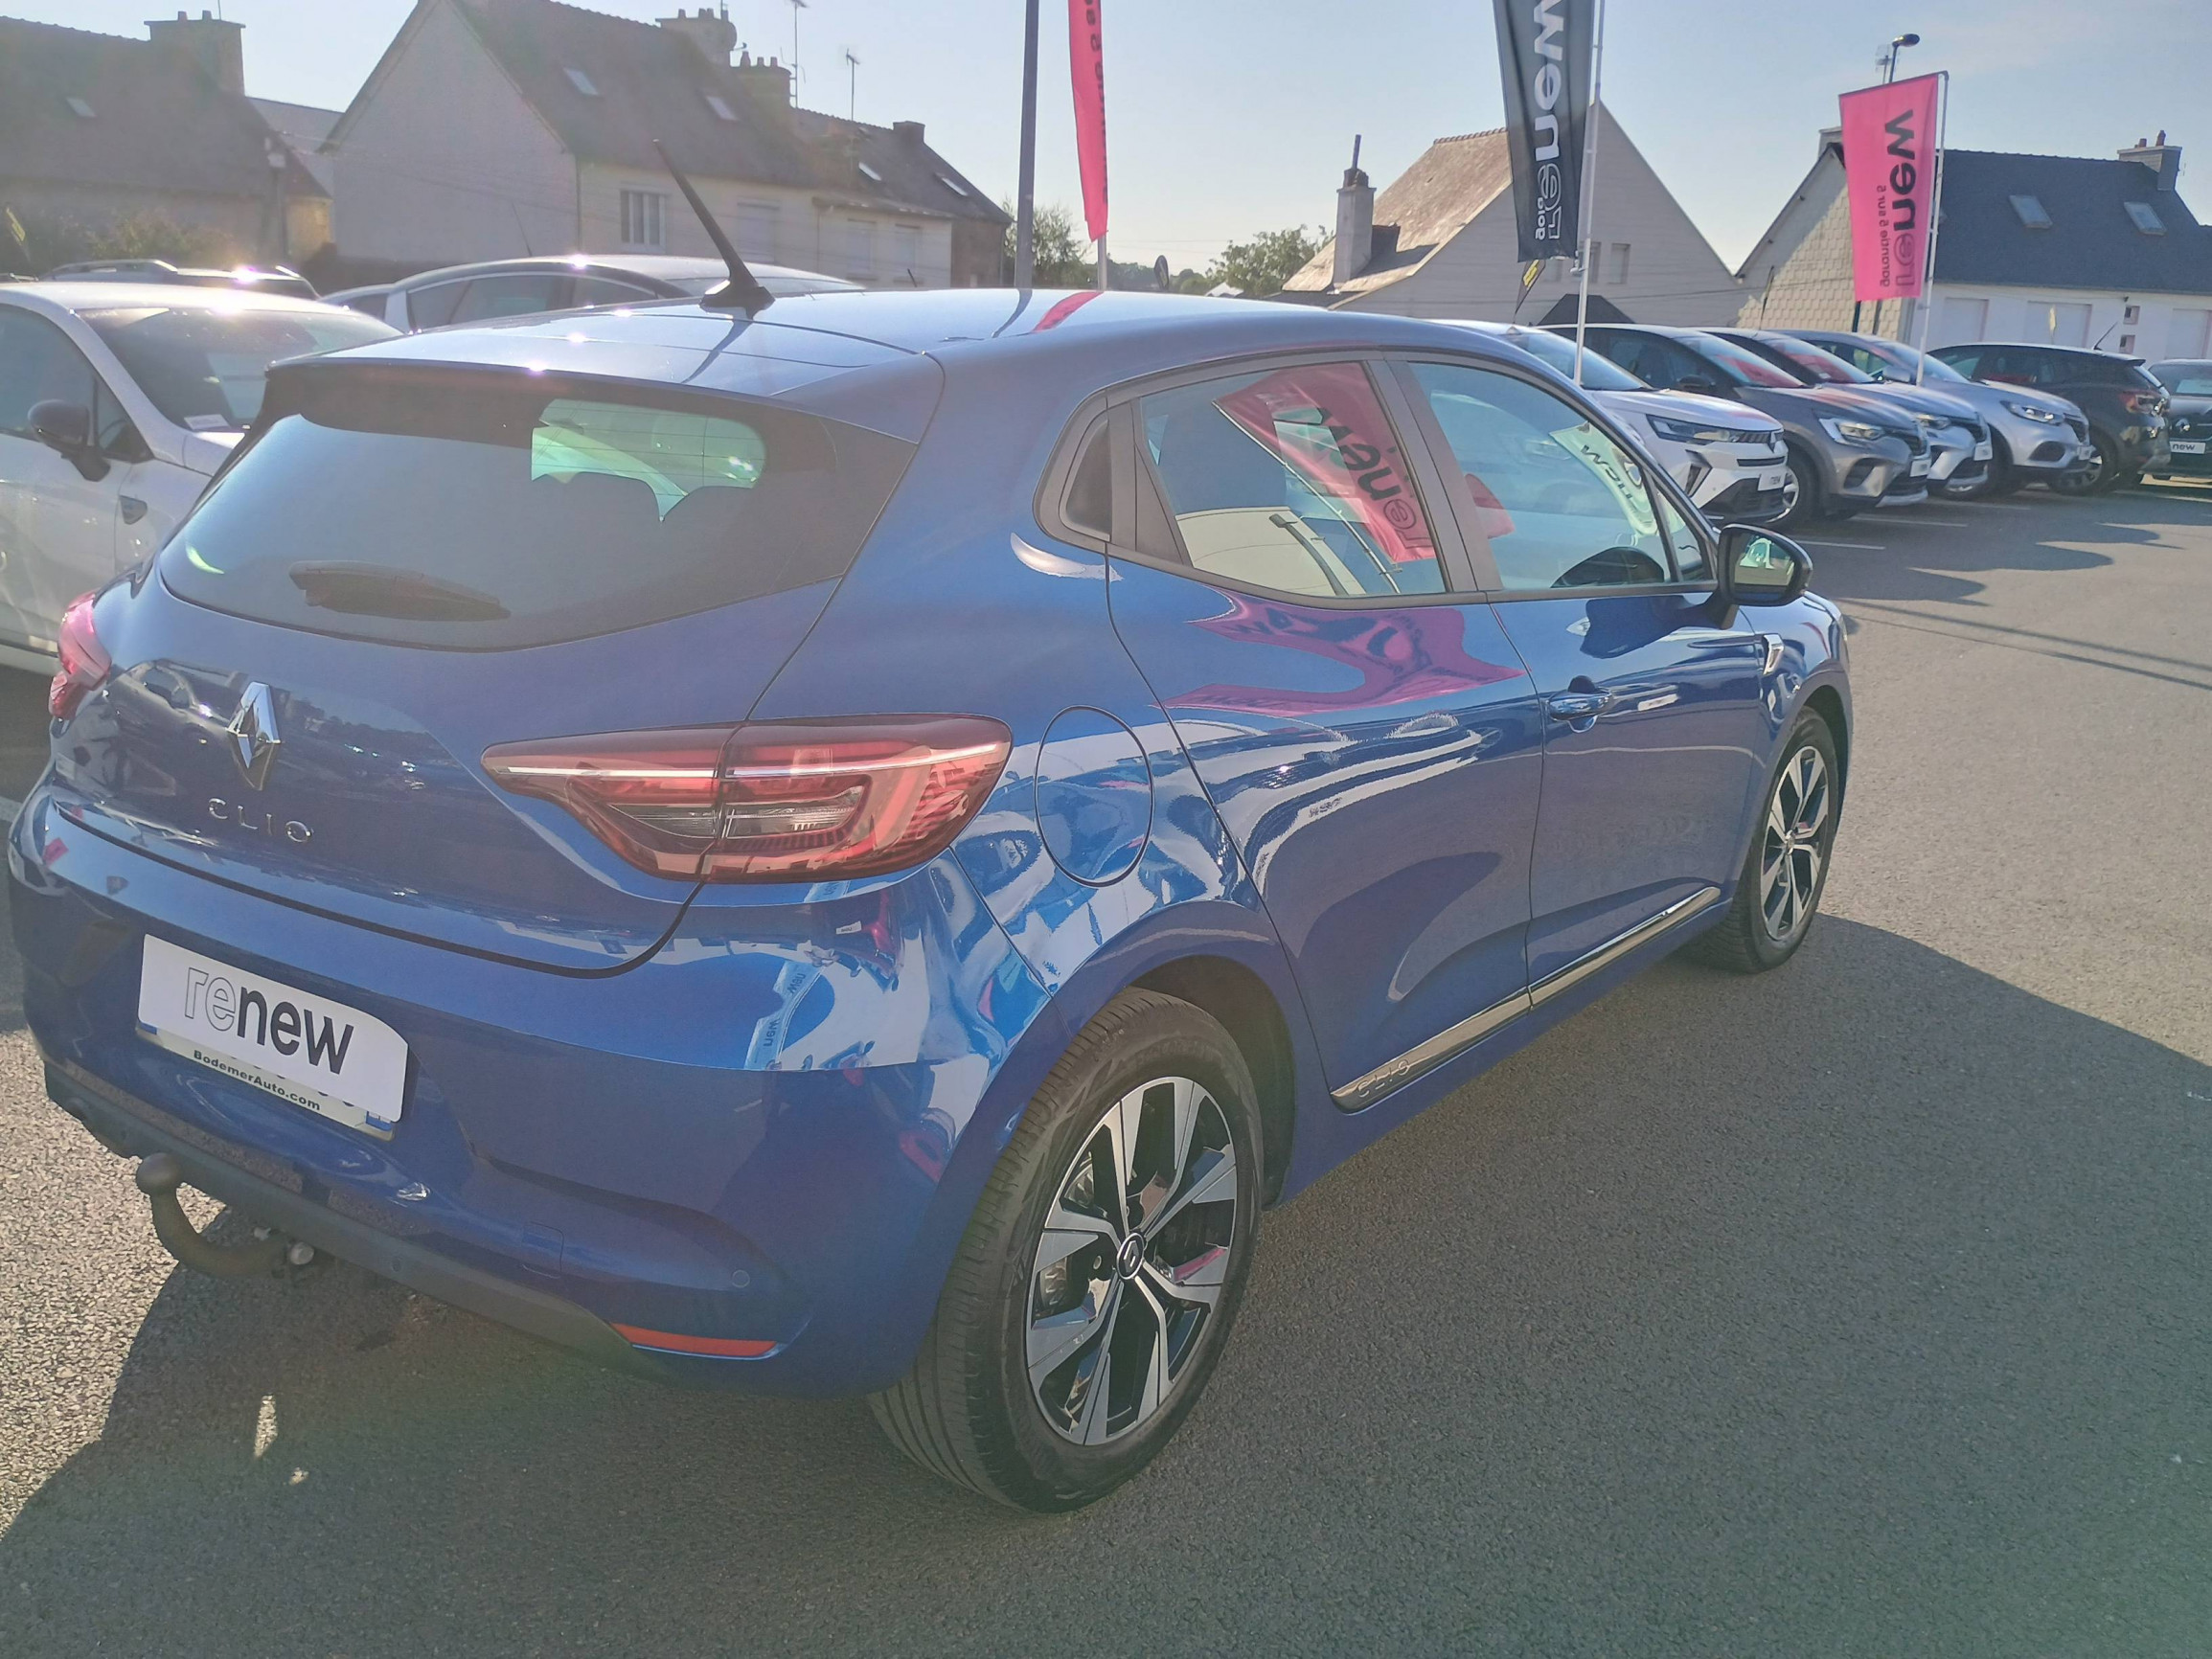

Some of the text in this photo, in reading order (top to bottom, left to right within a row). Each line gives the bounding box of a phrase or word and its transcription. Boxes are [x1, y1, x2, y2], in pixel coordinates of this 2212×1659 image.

[209, 798, 311, 843] CLIO
[184, 966, 354, 1076] renew
[194, 1049, 321, 1111] BodemerAuto.com
[1357, 1059, 1409, 1098] CLIO
